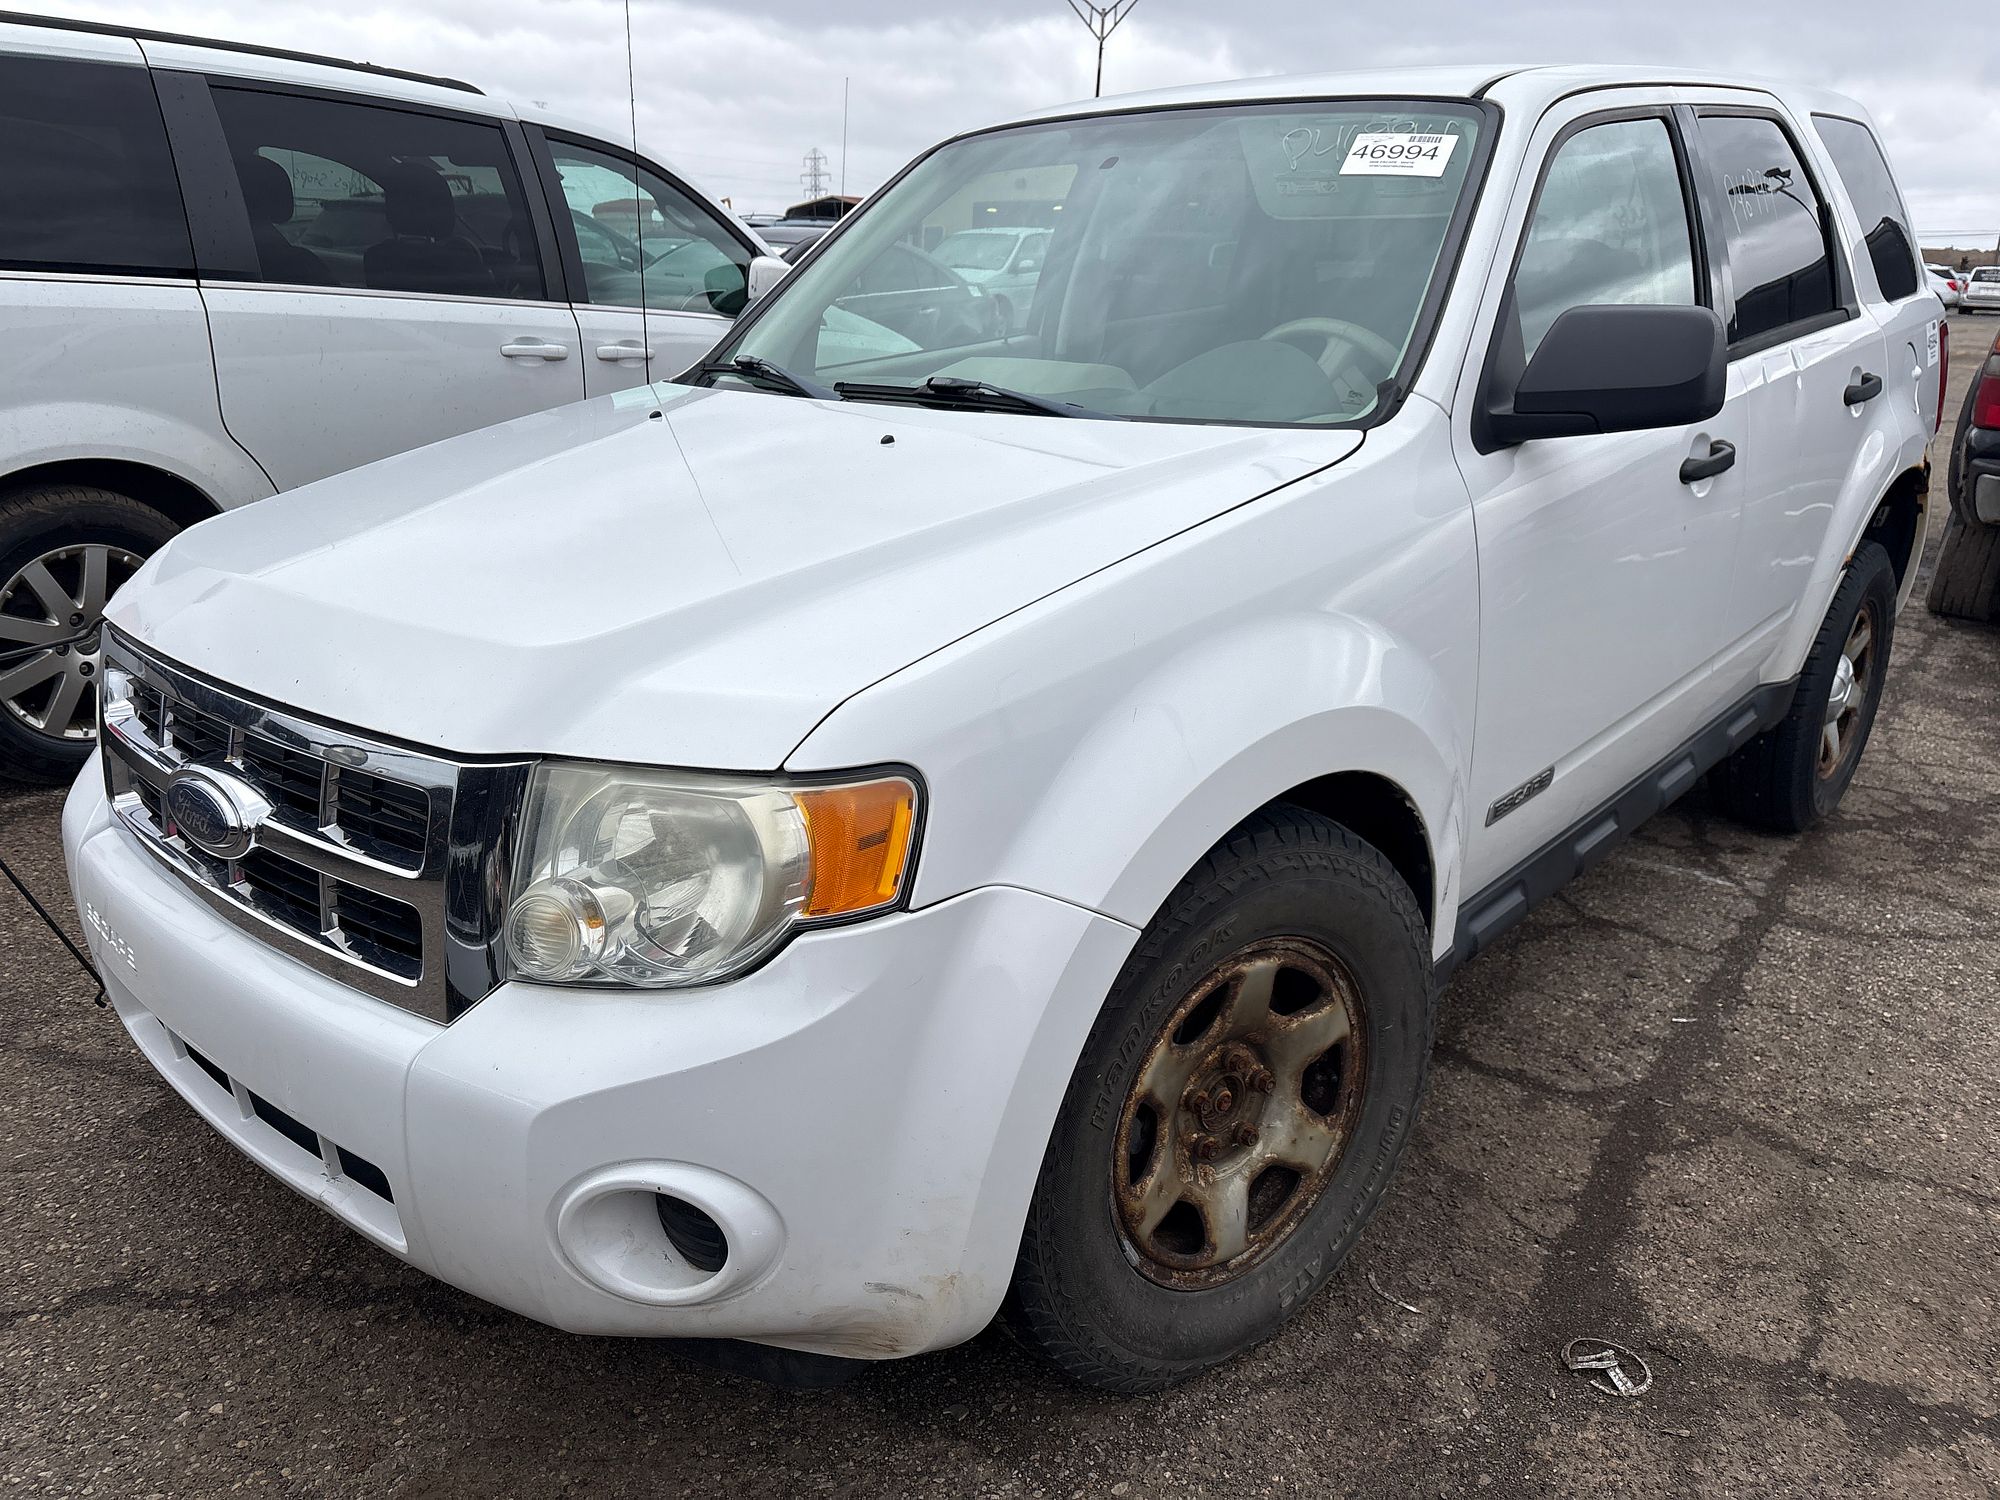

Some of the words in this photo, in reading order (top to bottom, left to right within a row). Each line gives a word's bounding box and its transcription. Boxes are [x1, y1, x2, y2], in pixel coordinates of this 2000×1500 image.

[1352, 144, 1439, 161] 46994
[174, 787, 214, 836] Ford
[1494, 770, 1551, 818] ESCAPE
